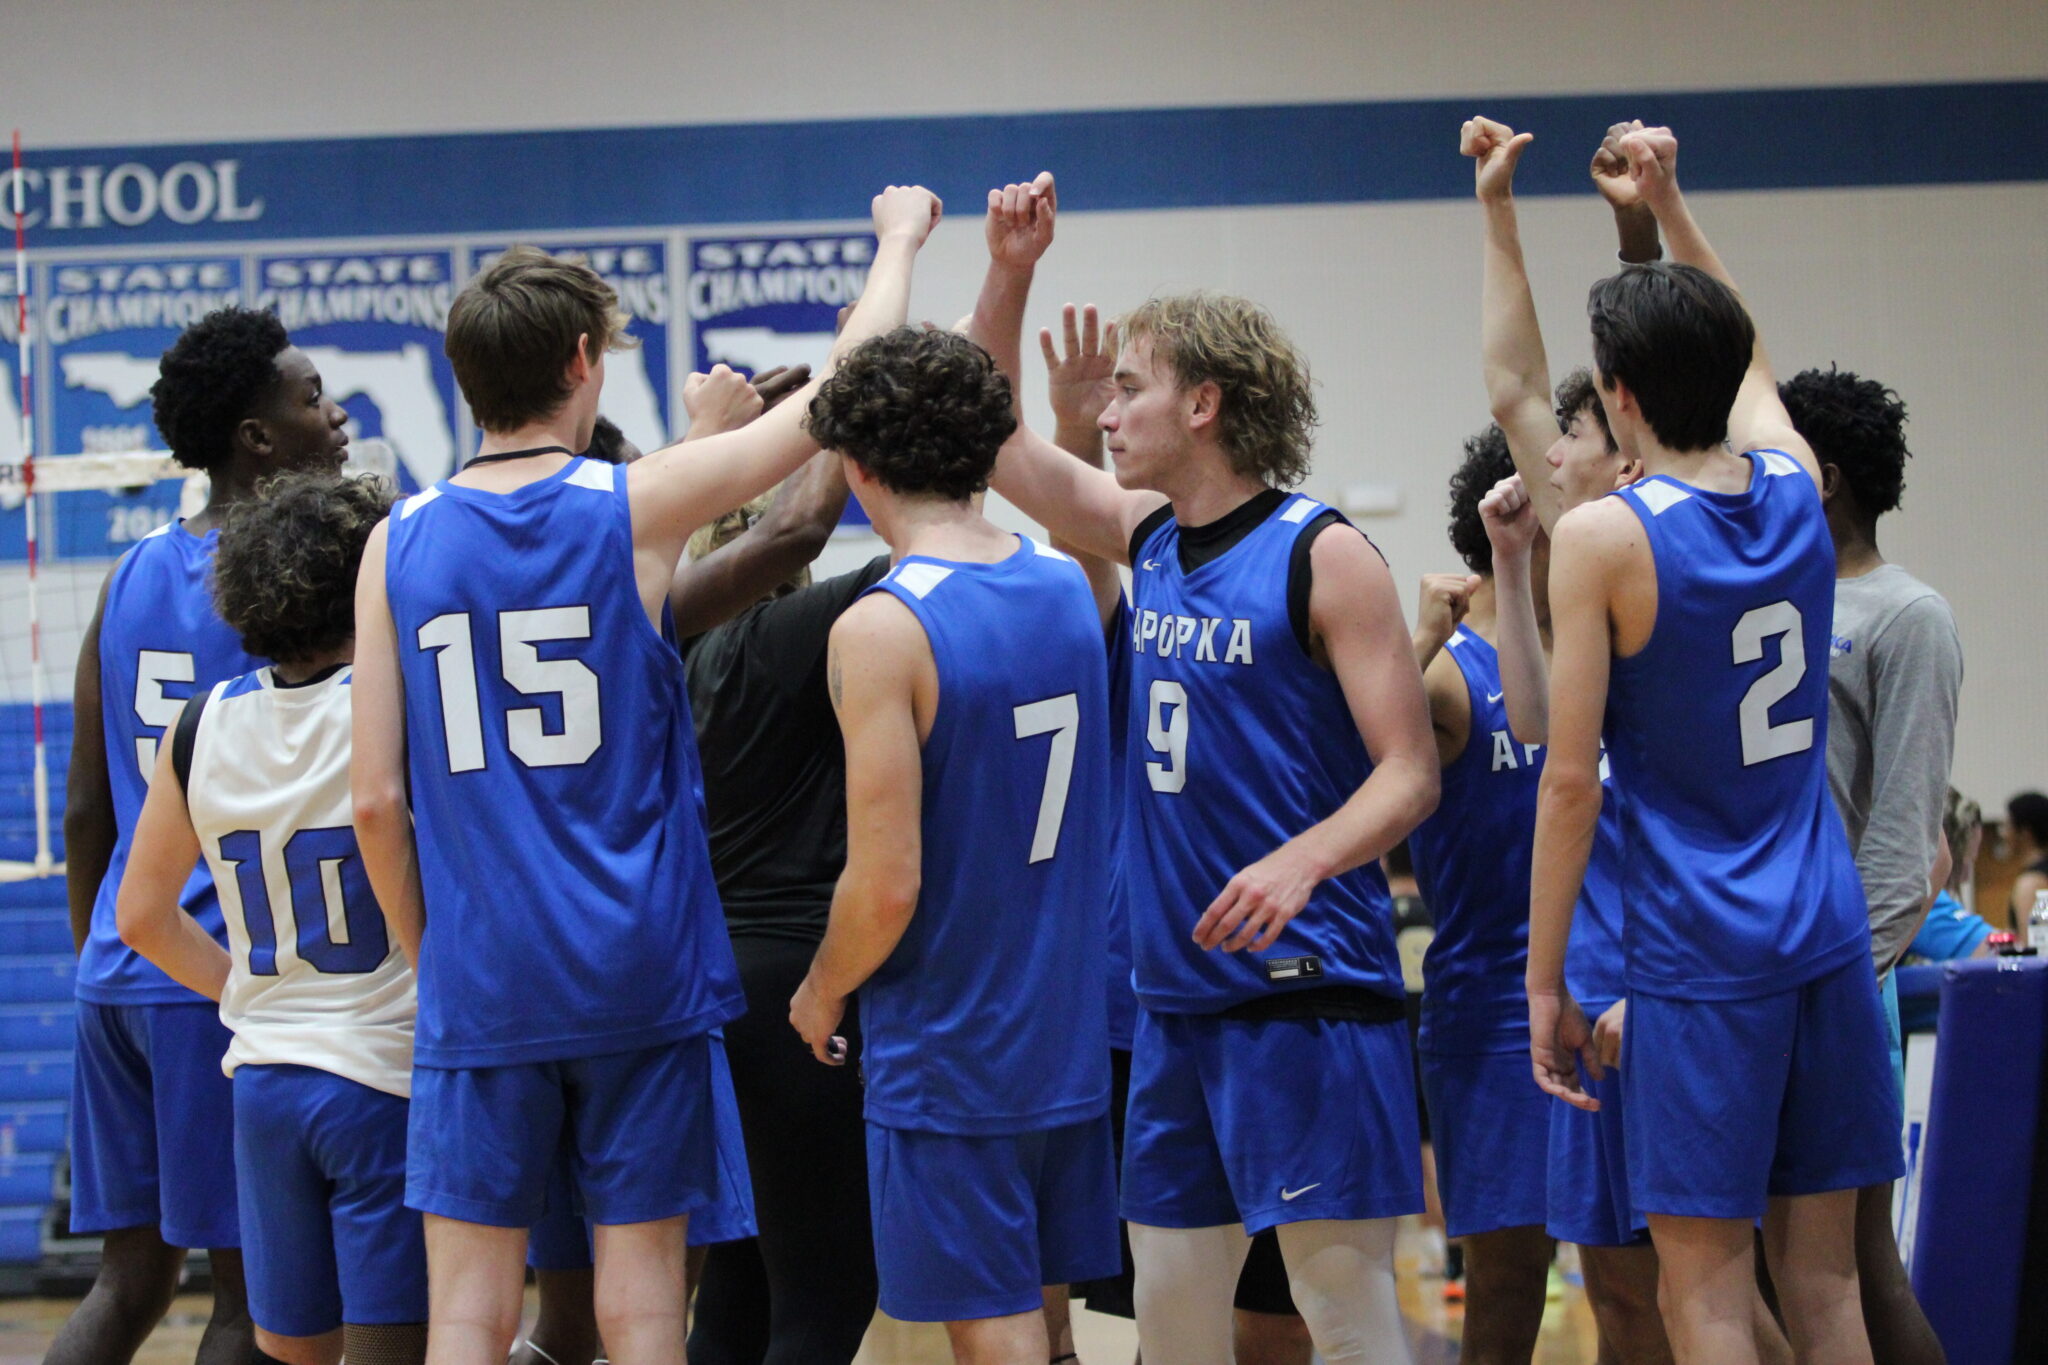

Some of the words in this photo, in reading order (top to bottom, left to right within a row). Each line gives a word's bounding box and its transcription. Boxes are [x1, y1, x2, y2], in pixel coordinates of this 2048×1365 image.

[57, 262, 230, 293] STATE
[264, 256, 441, 288] STATE
[698, 237, 874, 270] STATE
[416, 604, 602, 775] 15
[1133, 606, 1253, 664] APOPKA
[1731, 599, 1814, 767] 2
[134, 648, 196, 789] 5
[1145, 679, 1189, 794] 9
[1012, 691, 1080, 865] 7
[217, 825, 389, 977] 10
[1305, 960, 1315, 972] L
